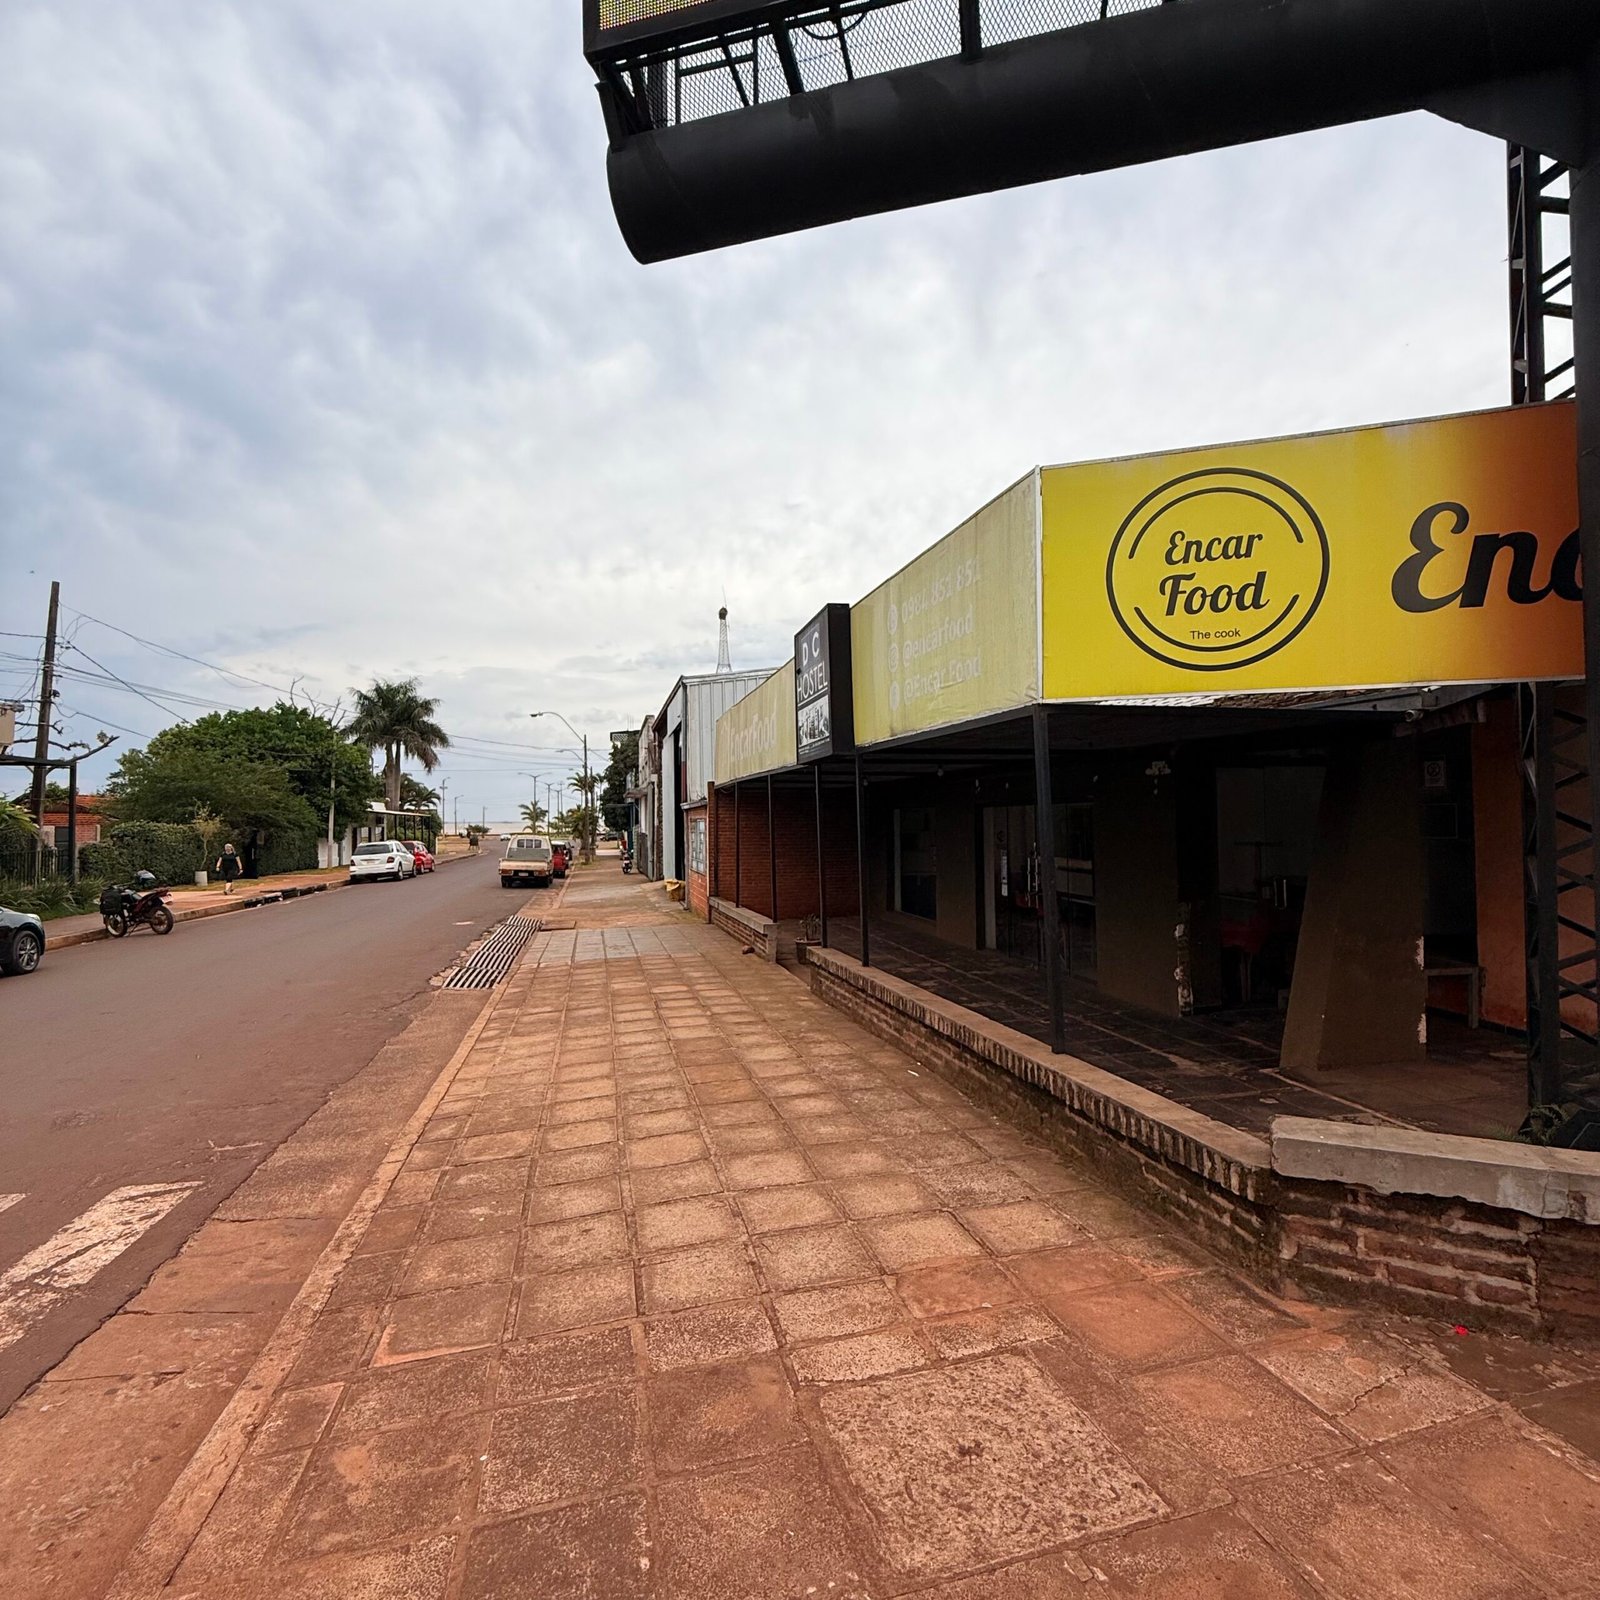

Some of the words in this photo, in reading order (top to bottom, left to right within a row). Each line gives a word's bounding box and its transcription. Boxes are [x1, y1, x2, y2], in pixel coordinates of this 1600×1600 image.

[1165, 530, 1263, 566] Encar
[1159, 571, 1269, 616] Food
[1189, 630, 1212, 640] The
[1214, 628, 1241, 640] cook
[797, 661, 828, 703] HOSTEL
